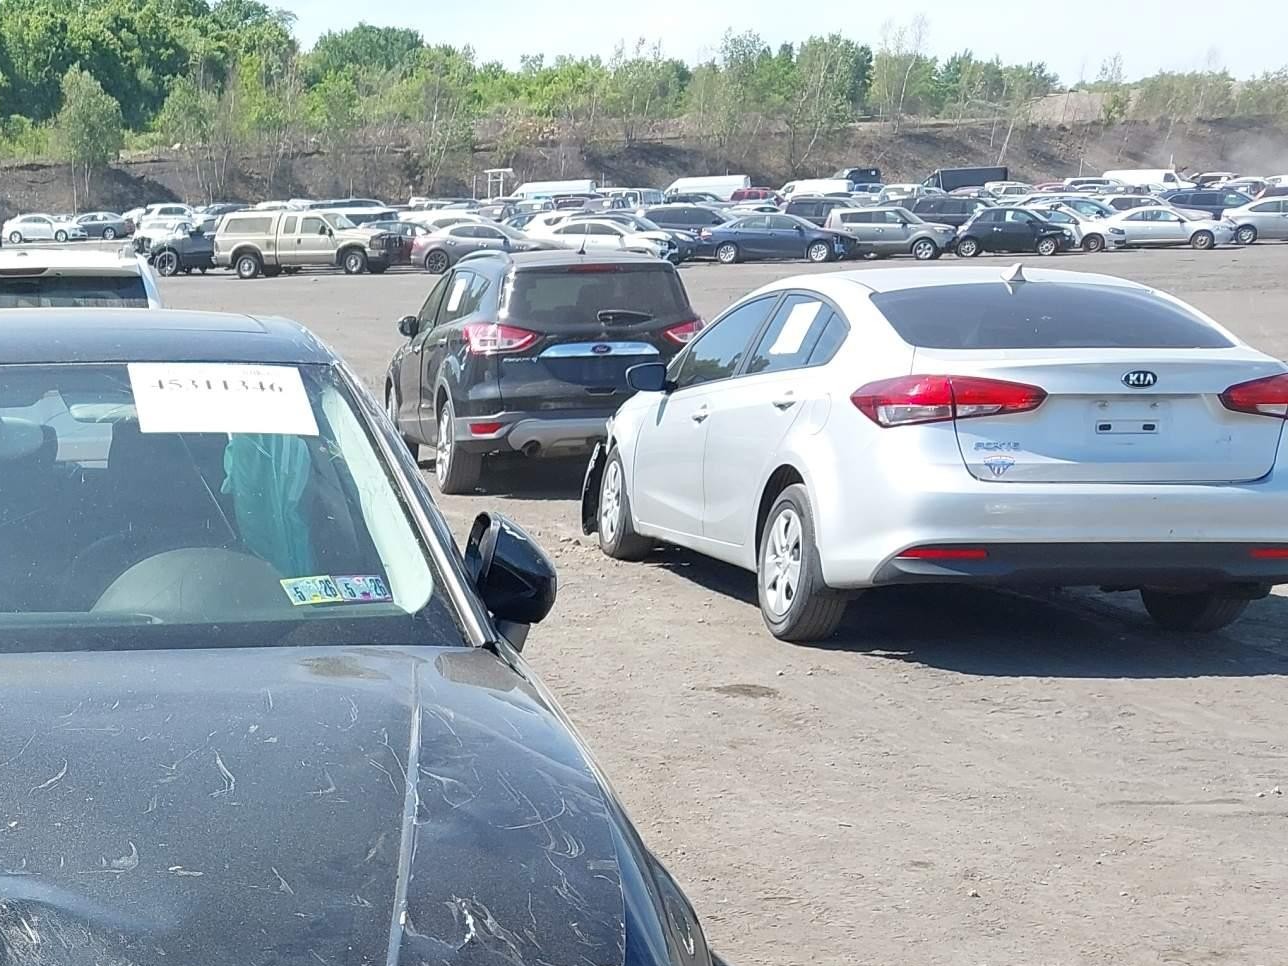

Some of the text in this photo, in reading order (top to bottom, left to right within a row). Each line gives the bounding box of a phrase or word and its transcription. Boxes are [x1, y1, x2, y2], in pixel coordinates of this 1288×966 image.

[1128, 373, 1154, 385] KIA
[293, 586, 306, 602] 5
[344, 583, 357, 598] 5
